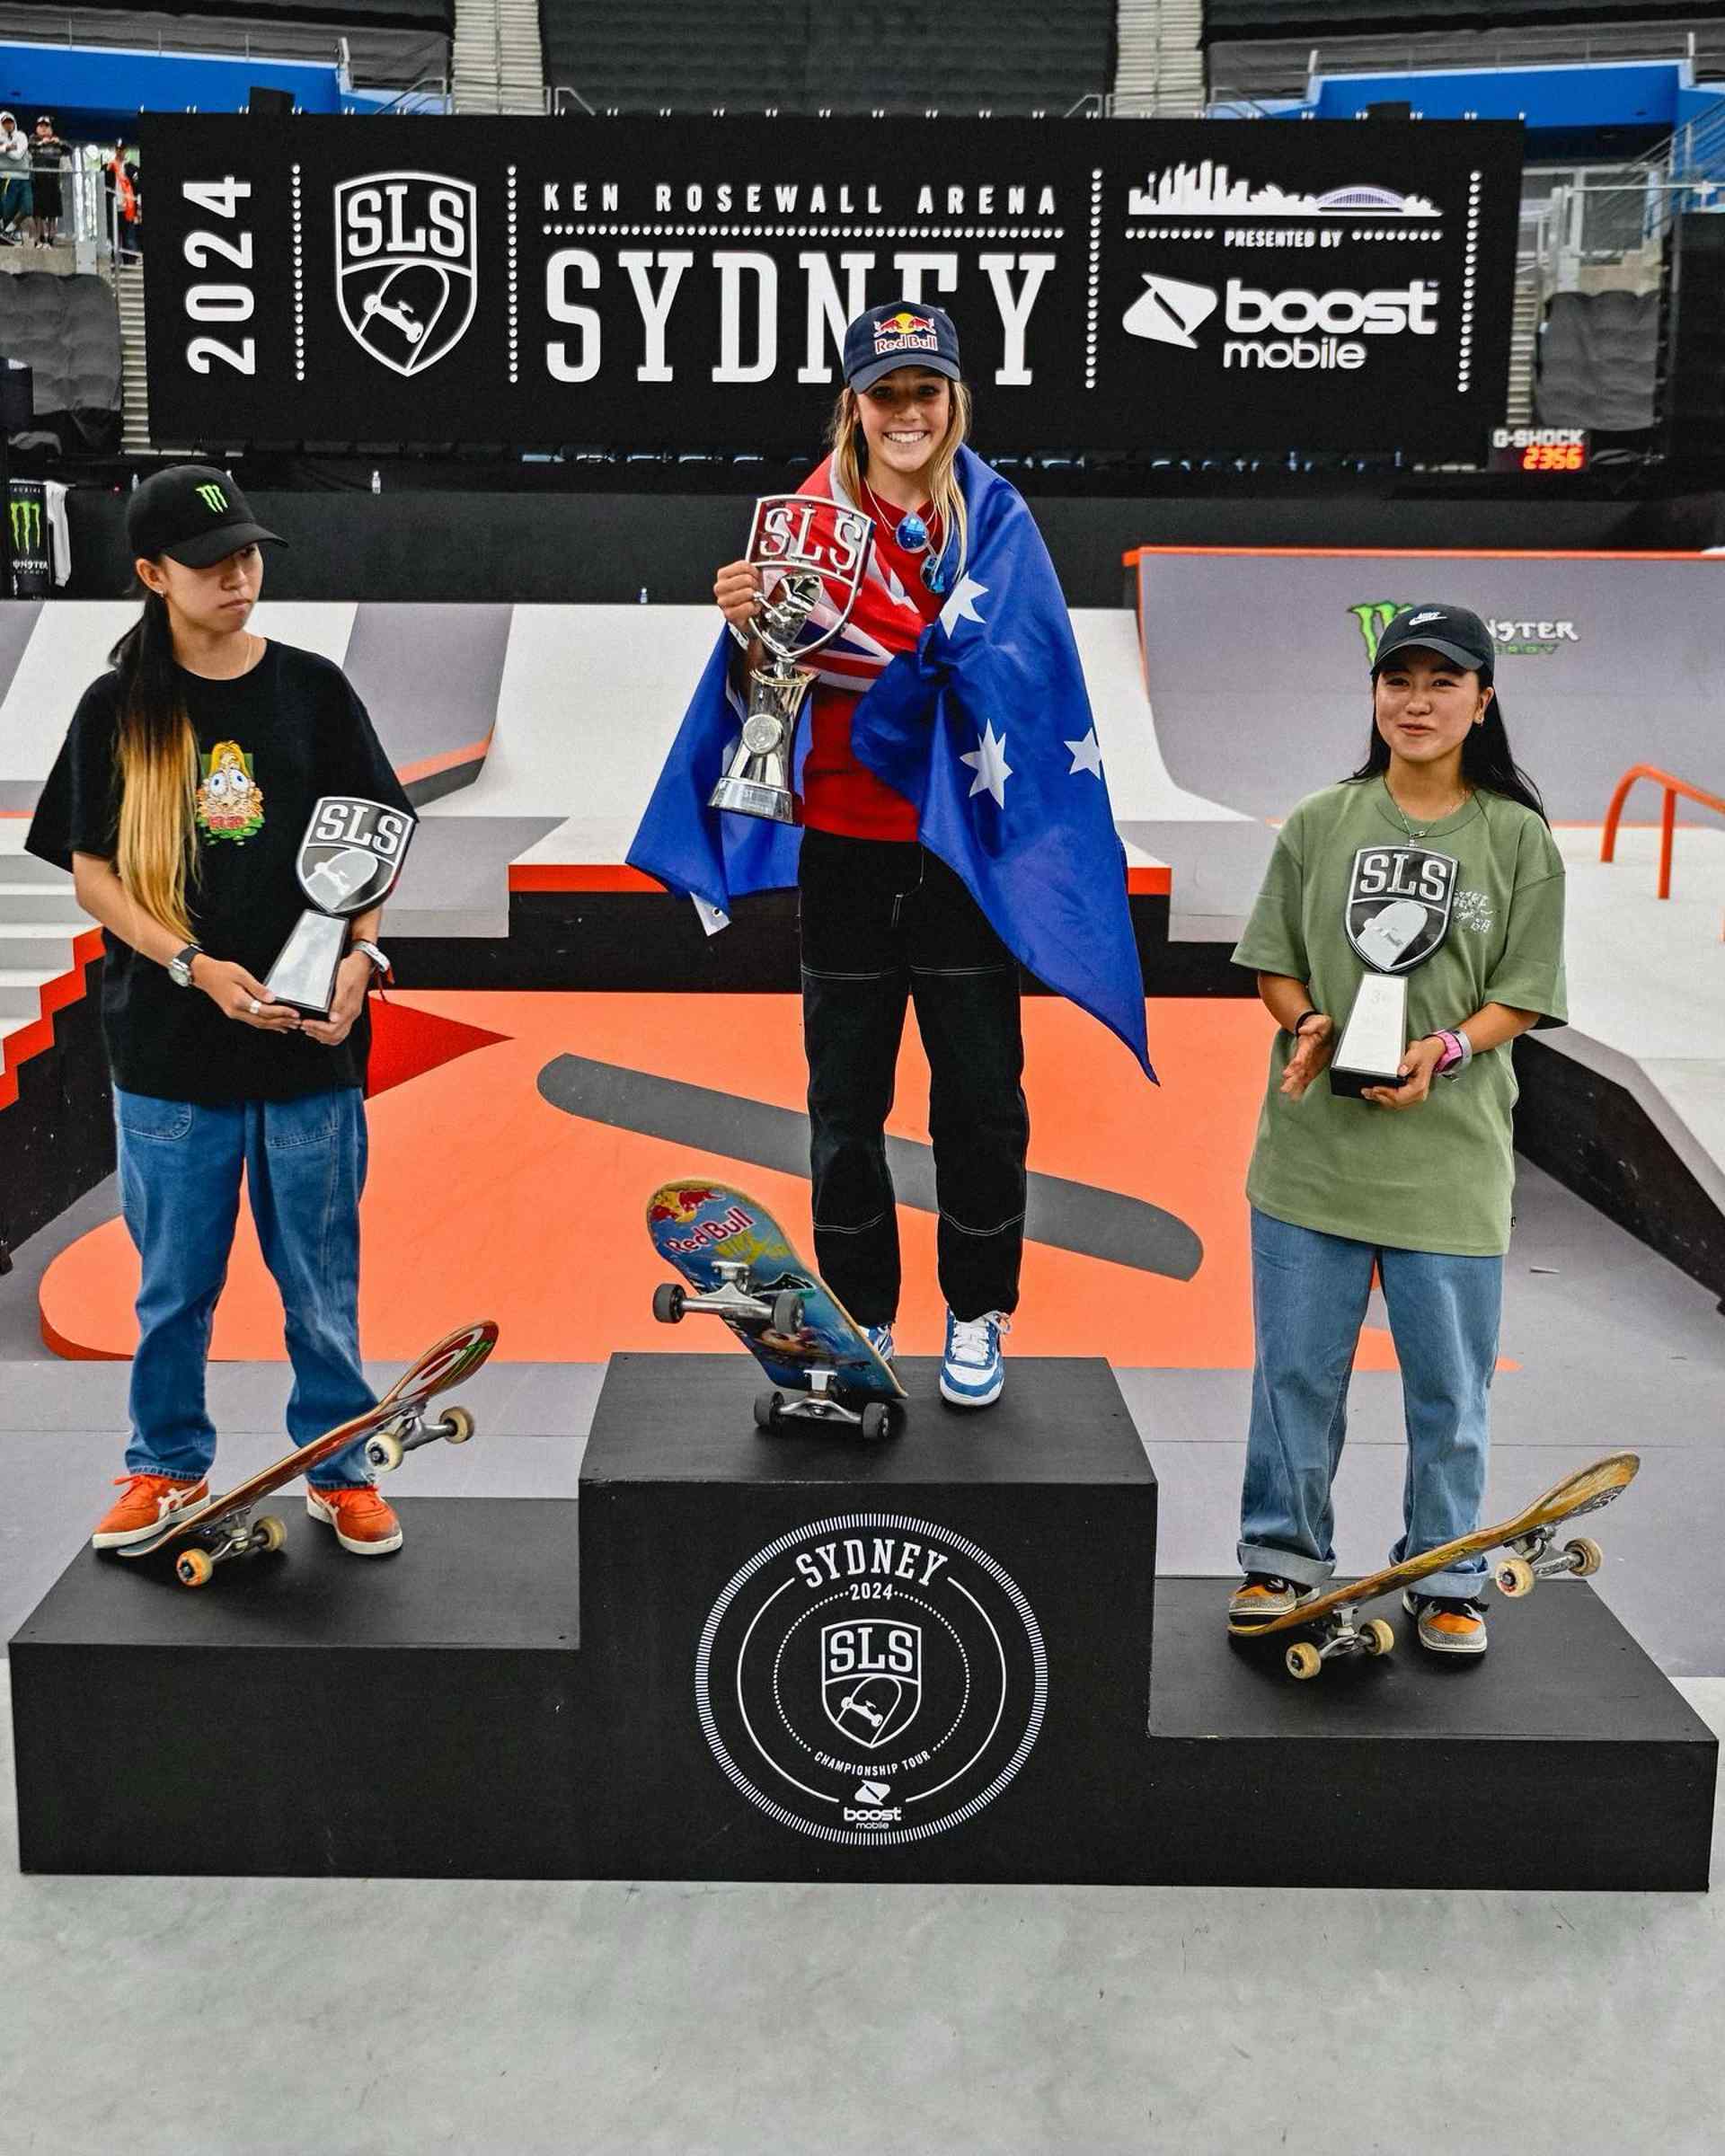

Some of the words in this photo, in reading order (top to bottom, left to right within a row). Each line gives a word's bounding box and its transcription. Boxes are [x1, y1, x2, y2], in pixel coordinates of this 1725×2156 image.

[544, 183, 618, 212] KEN
[656, 184, 882, 214] ROSEWALL
[917, 185, 1056, 215] ARENA
[347, 185, 465, 258] SLS
[1224, 229, 1315, 248] PRESENTED
[1320, 230, 1343, 248] BY
[182, 176, 256, 376] 2024
[1225, 278, 1438, 335] boost
[875, 333, 907, 355] Red
[907, 333, 938, 352] Bull
[1223, 336, 1367, 369] mobile
[1492, 429, 1585, 449] G-SHOCK
[1523, 446, 1584, 470] 2356
[760, 507, 862, 570] SLS
[1485, 618, 1580, 642] NSTER
[315, 803, 403, 855] SLS
[1359, 853, 1447, 902] SLS
[665, 1224, 711, 1255] Red
[700, 1206, 756, 1241] Bull
[795, 1537, 949, 1589] SYDNEY
[849, 1582, 894, 1602] 2024
[830, 1626, 914, 1674] SLS
[814, 1751, 898, 1777] CHAMPIONSHIP
[901, 1750, 932, 1772] TOUR
[844, 1807, 902, 1822] boost
[855, 1822, 889, 1830] mobile
